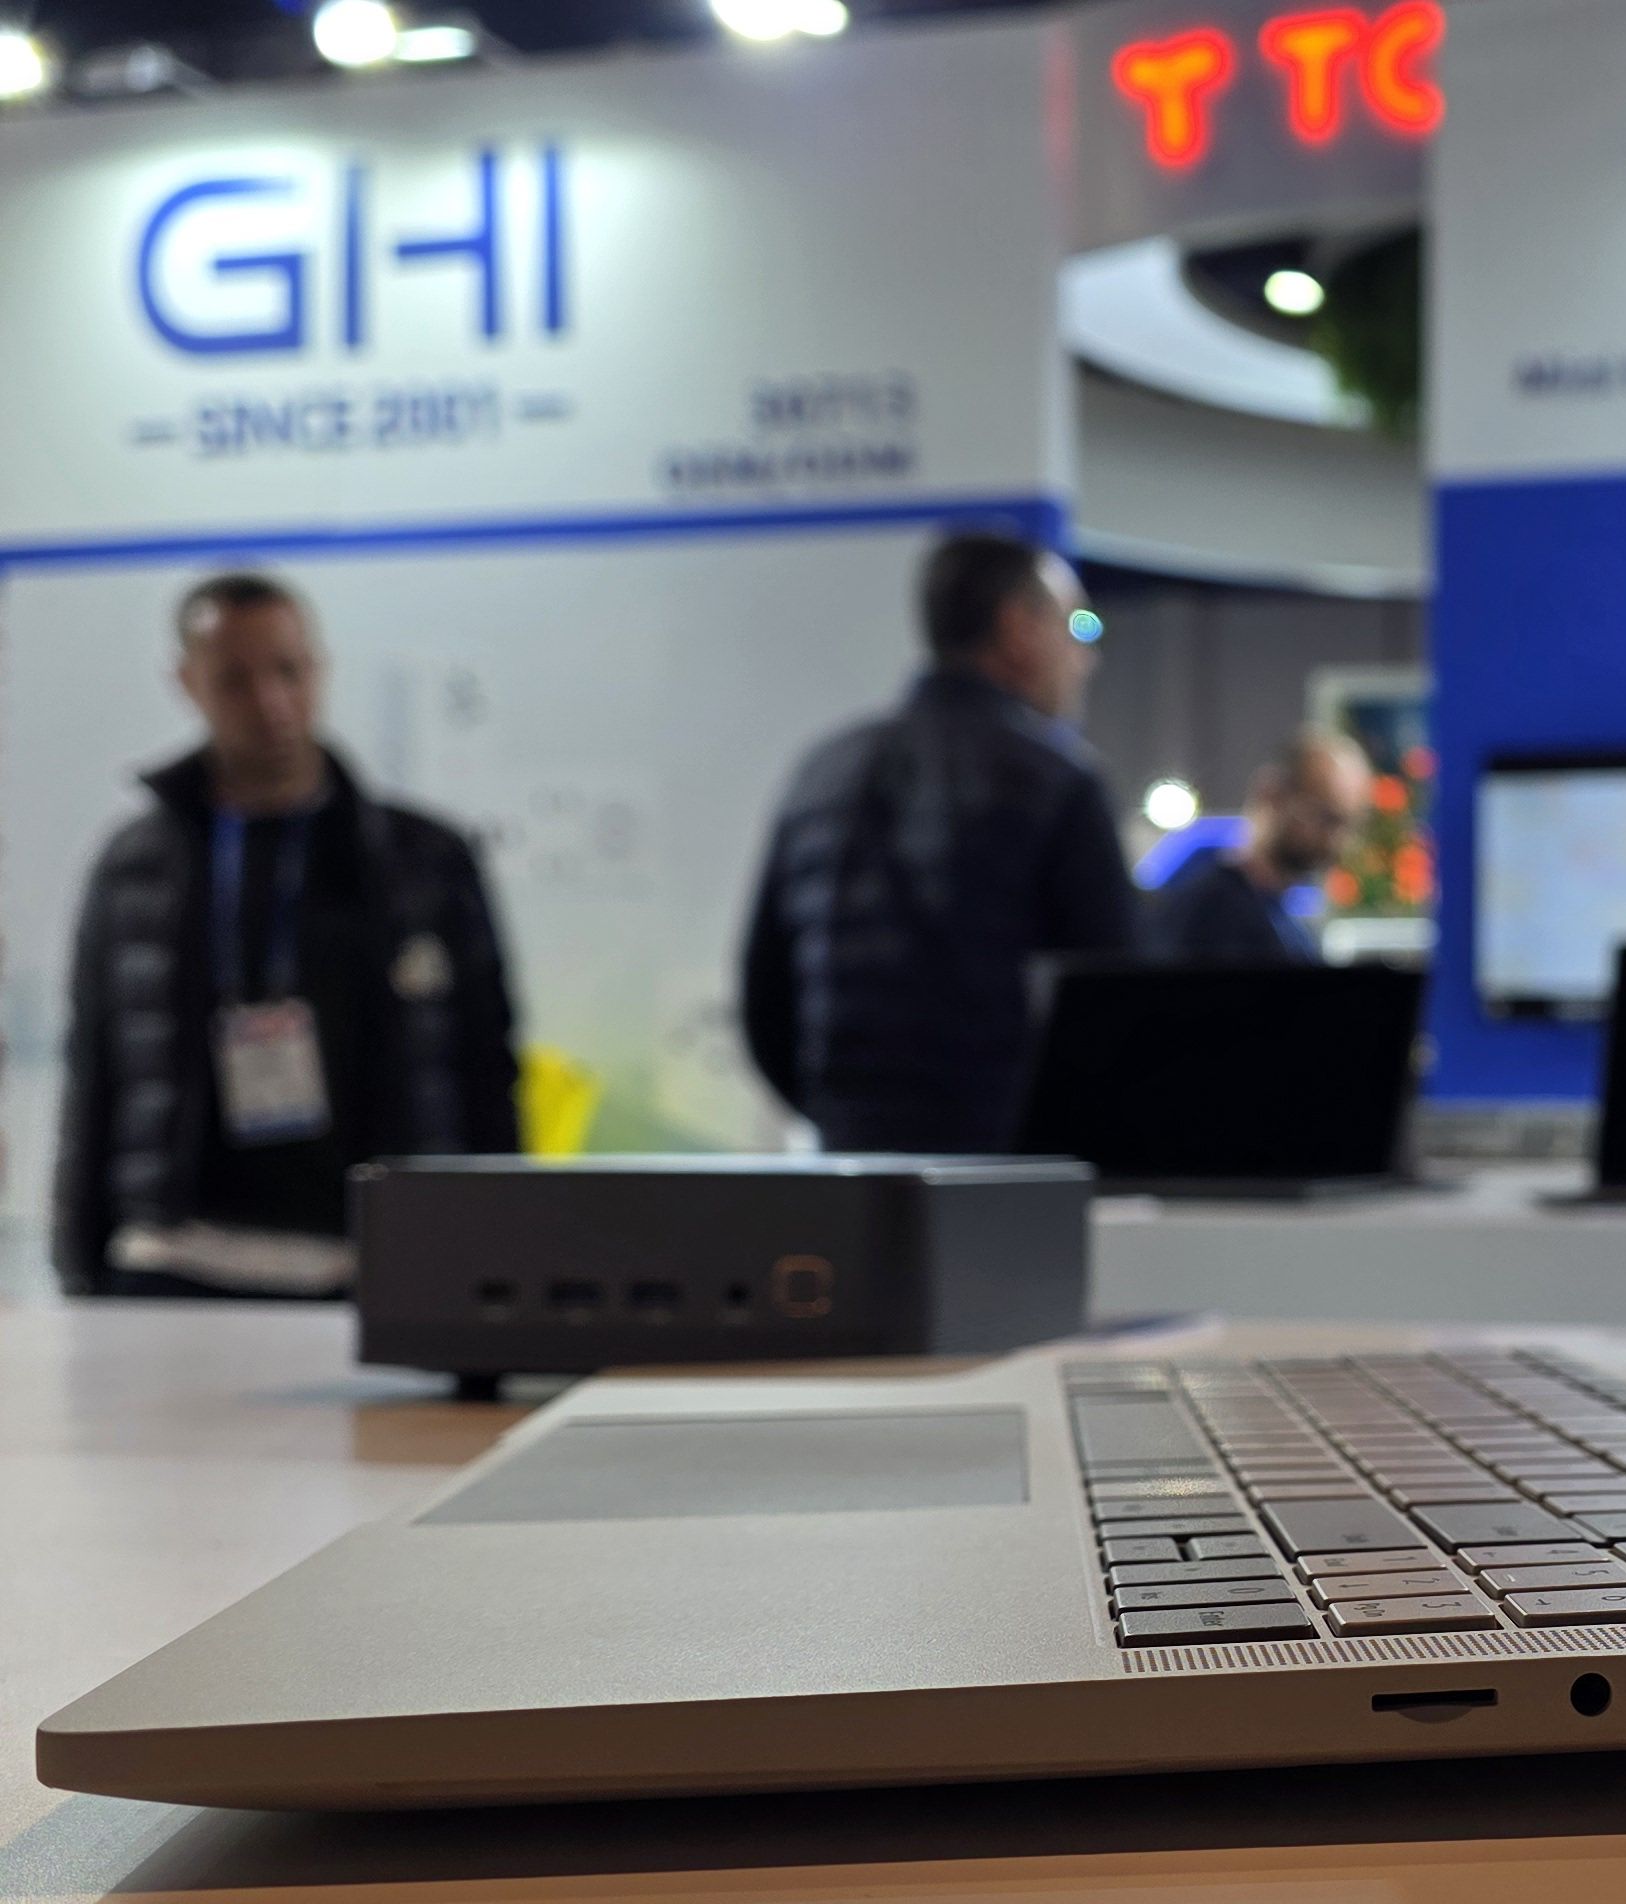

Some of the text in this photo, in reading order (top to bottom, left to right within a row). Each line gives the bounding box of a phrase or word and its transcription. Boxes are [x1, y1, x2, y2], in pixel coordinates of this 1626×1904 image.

[136, 141, 568, 356] GHI
[189, 382, 502, 454] SINCE 2001
[1198, 1610, 1225, 1627] Enter
